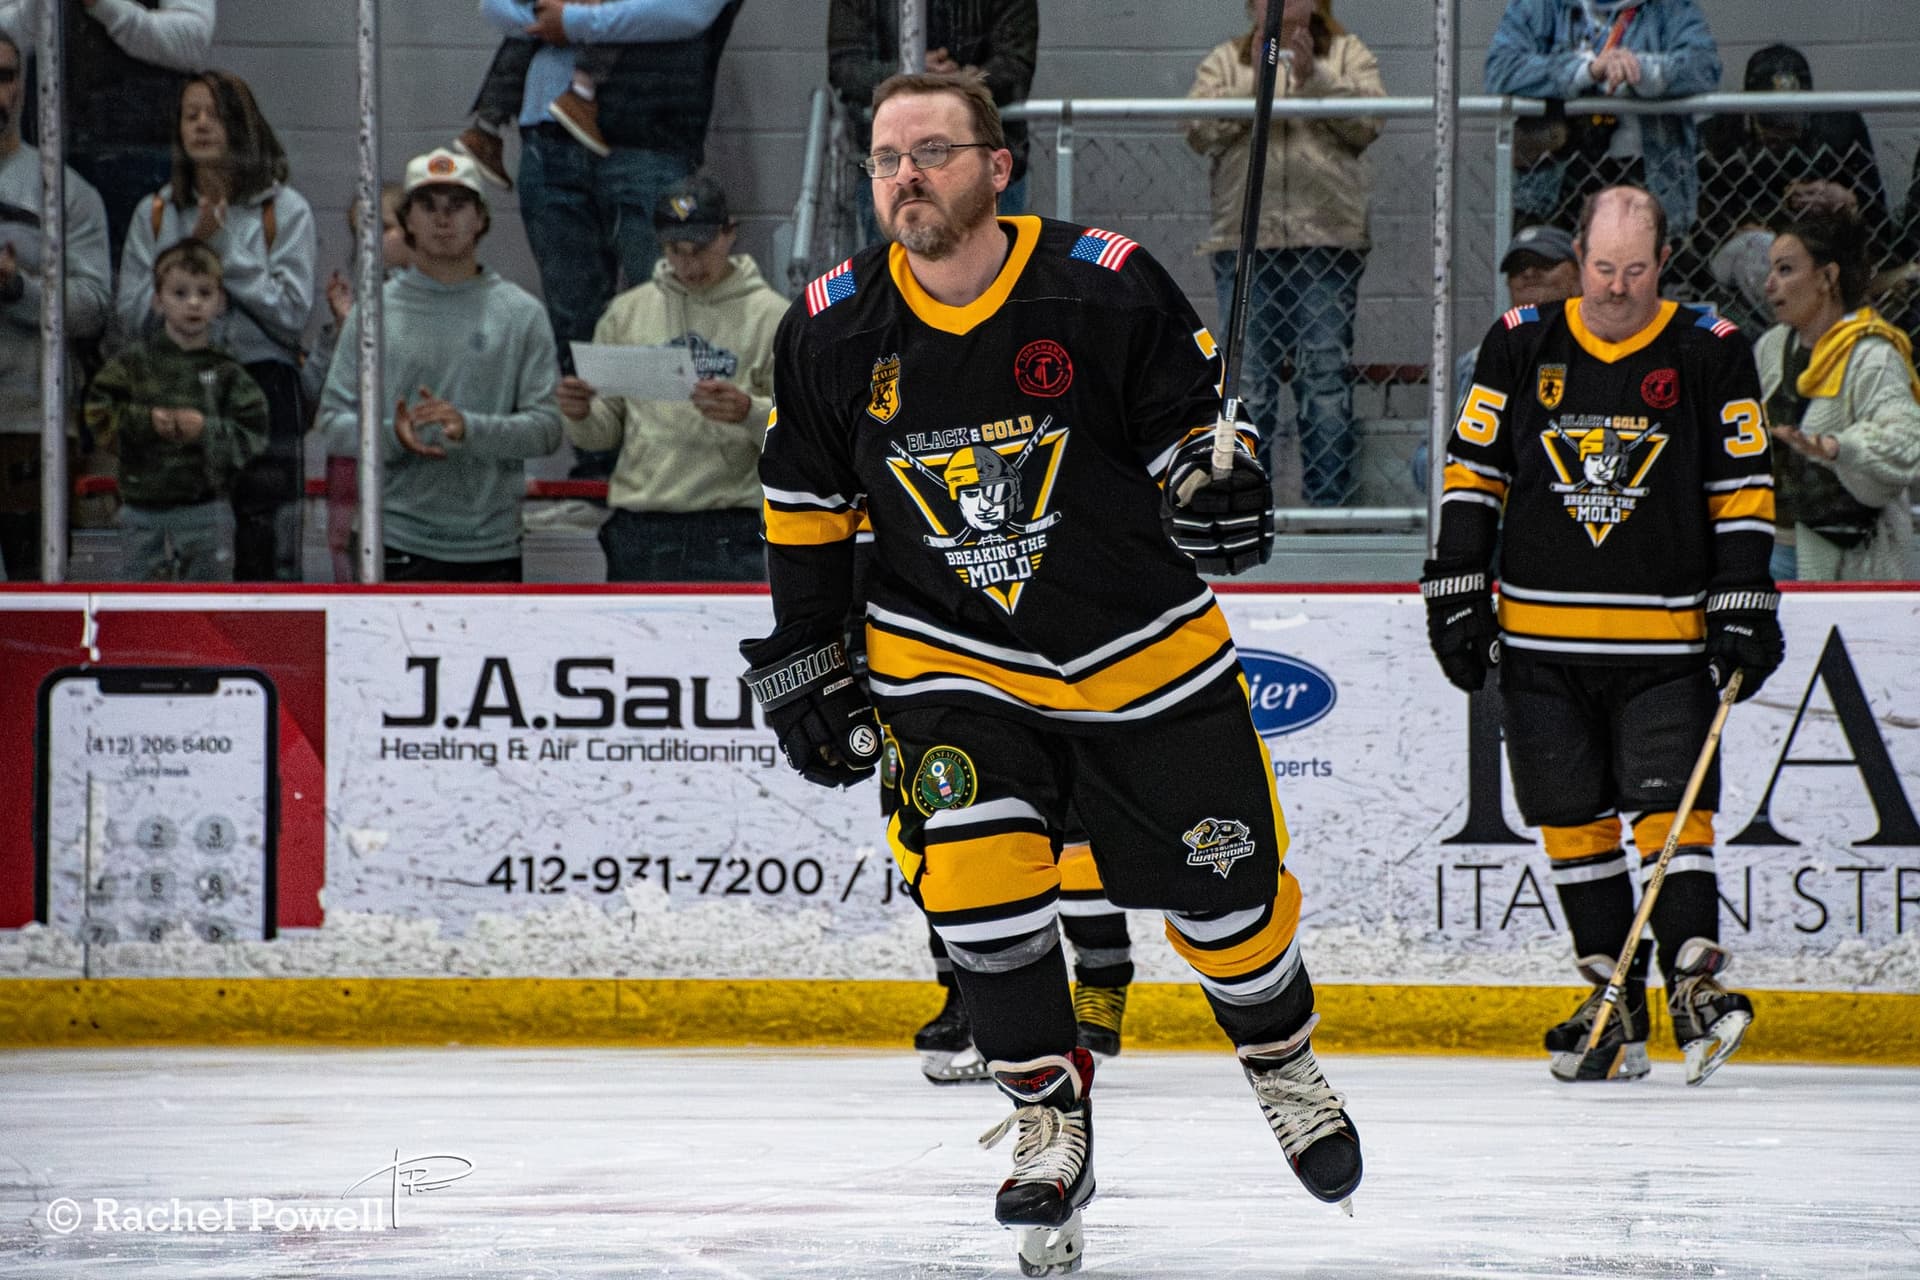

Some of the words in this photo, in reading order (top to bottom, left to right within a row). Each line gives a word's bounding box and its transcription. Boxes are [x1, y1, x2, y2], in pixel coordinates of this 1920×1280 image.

[1456, 384, 1508, 447] 5
[1560, 414, 1604, 428] BLACK
[1612, 416, 1649, 430] GOLD
[1721, 399, 1767, 458] 3
[906, 427, 970, 452] BLACK
[971, 431, 981, 443] &
[981, 415, 1034, 442] GOLD
[1563, 494, 1614, 507] BREAKING
[1615, 497, 1637, 510] THE
[1576, 506, 1621, 523] MOLD
[945, 542, 1016, 566] BREAKING
[1020, 534, 1048, 551] THE
[967, 556, 1032, 588] MOLD
[382, 656, 775, 729] J.A.Sau
[380, 737, 498, 767] Heating
[508, 737, 530, 761] &
[538, 738, 579, 761] Air
[587, 738, 776, 768] Conditioning
[1191, 845, 1252, 862] WARRIORS
[486, 855, 823, 895] 412-931-7200
